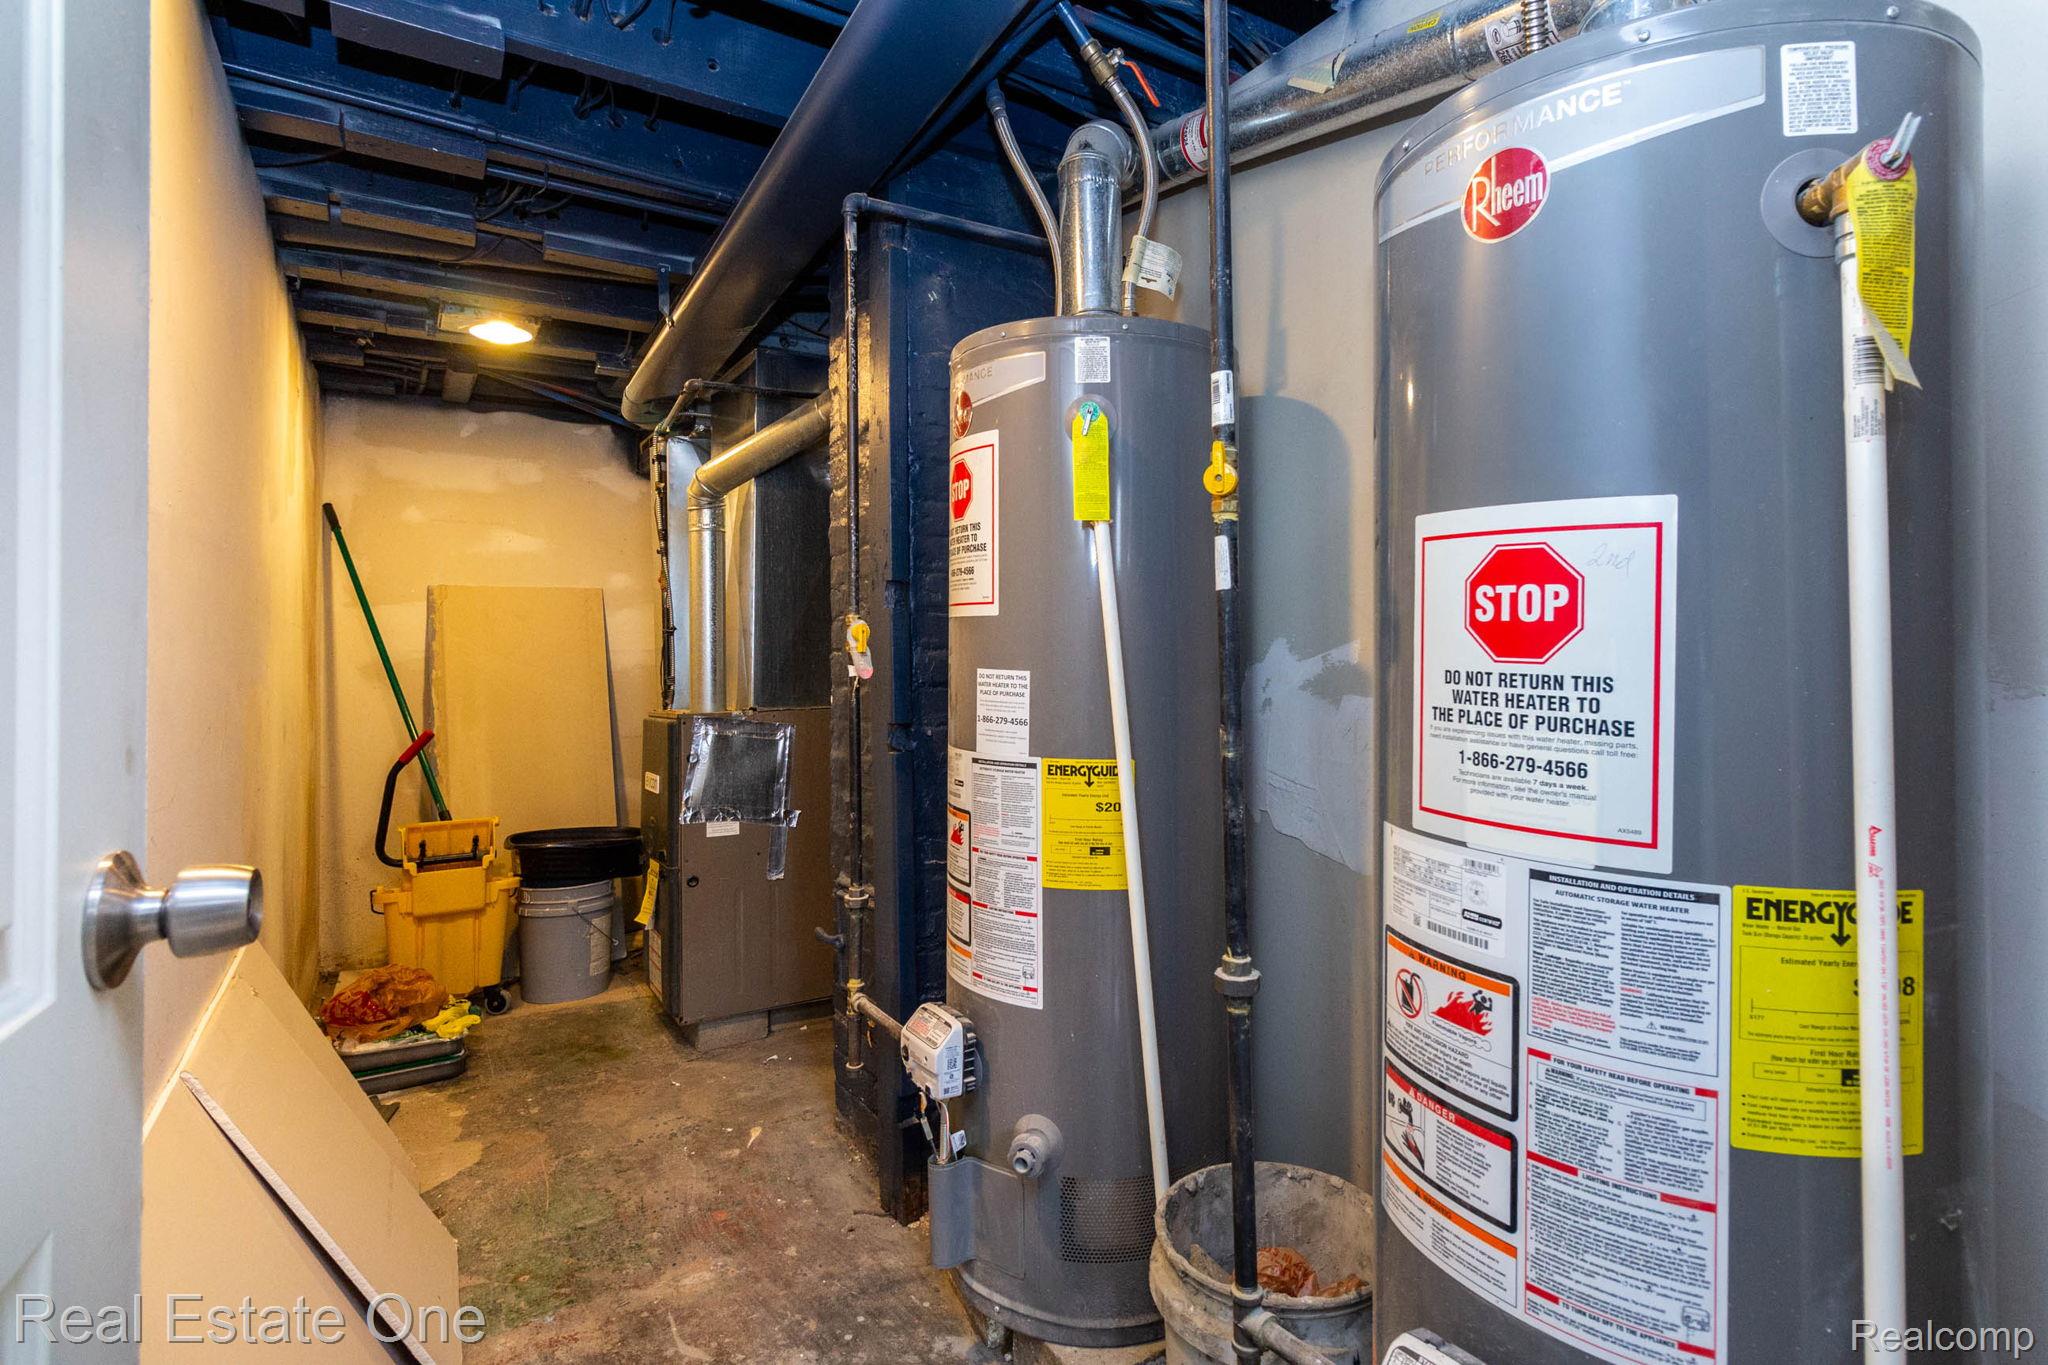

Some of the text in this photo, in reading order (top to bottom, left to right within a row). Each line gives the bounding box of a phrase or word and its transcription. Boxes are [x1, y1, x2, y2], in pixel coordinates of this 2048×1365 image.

[1471, 152, 1544, 232] Rheem
[952, 478, 970, 502] STOP
[970, 522, 981, 531] THIS
[971, 533, 978, 542] TO
[962, 542, 987, 554] PURCHASE
[1474, 583, 1570, 622] STOP
[1445, 670, 1614, 693] DO NOT RETURN THIS
[1000, 690, 1025, 698] PURCHASE
[1452, 689, 1600, 714] WATER HEATER TO
[977, 715, 1029, 727] 1-866-279-4566
[1432, 706, 1635, 738] THE PLACE OF PURCHASE
[1527, 744, 1553, 752] general
[1554, 746, 1589, 755] questions
[1591, 748, 1604, 756] call
[1585, 739, 1614, 749] missing
[1047, 764, 1119, 777] ENERGYGUID
[1459, 750, 1588, 779] 1-866-279-4566
[1458, 769, 1490, 779] Technicians
[1503, 775, 1532, 785] available
[1539, 780, 1557, 789] days
[1565, 783, 1589, 791] week.
[1470, 788, 1571, 807] provided with your water heater.
[1540, 788, 1567, 798] owner's
[1569, 792, 1598, 801] manual
[1095, 802, 1121, 812] $20
[1549, 874, 1695, 901] INSTALLATION AND OPERATION DETAILS
[1555, 889, 1690, 914] AUTOMATIC STORAGE WATER HEATER
[1746, 896, 1913, 926] ENERGYGE
[1418, 953, 1467, 981] WARNING
[1780, 957, 1816, 966] Estimated
[1818, 959, 1840, 968] Yearly
[1448, 1045, 1470, 1060] HAZARD
[1553, 1057, 1690, 1095] FOR YOUR SAFETY READ BEFORE OPERATING
[1415, 1091, 1457, 1124] DANGER
[1581, 1172, 1658, 1201] LIGHTING INSTRUCTIONS
[1562, 1301, 1570, 1310] TO
[1571, 1304, 1586, 1318] TURN
[1588, 1311, 1601, 1322] GAS
[1615, 1322, 1625, 1333] TO
[1626, 1326, 1638, 1338] THE
[1639, 1330, 1676, 1349] APPLIANCE
